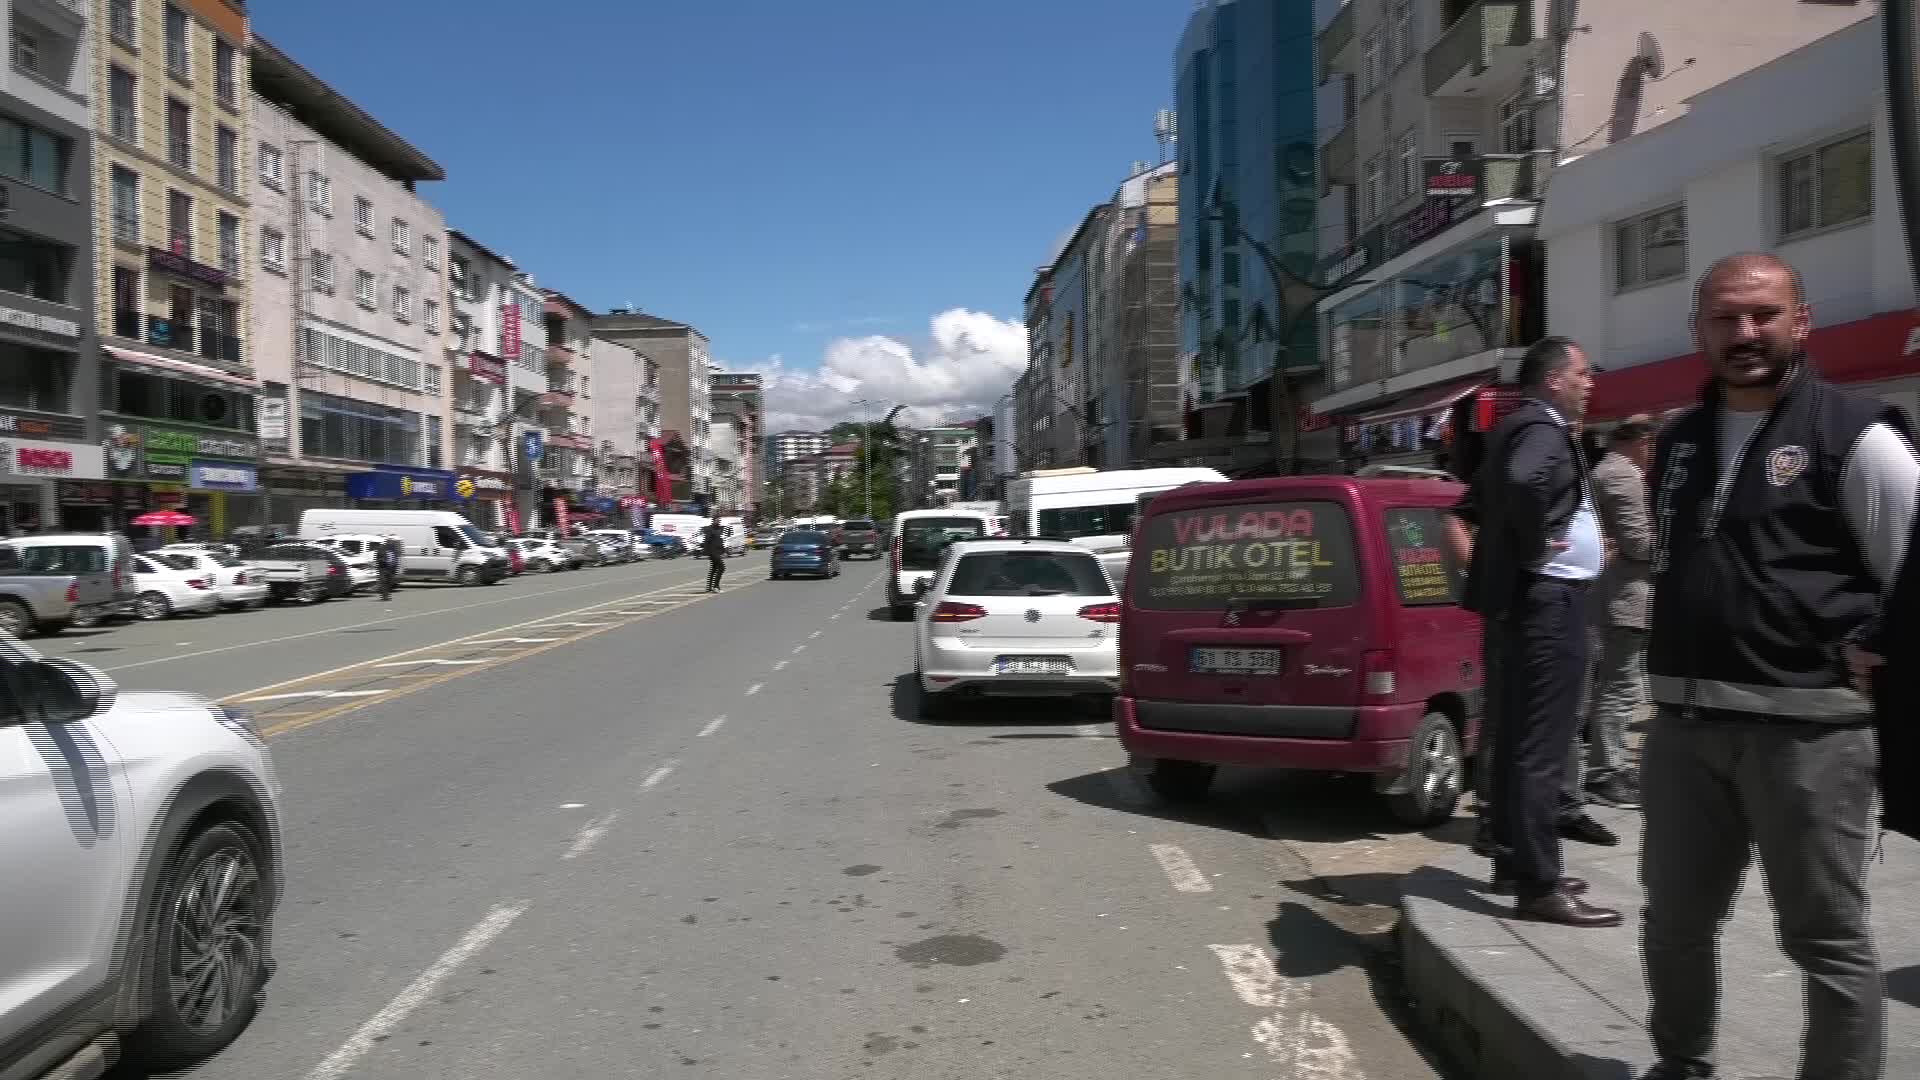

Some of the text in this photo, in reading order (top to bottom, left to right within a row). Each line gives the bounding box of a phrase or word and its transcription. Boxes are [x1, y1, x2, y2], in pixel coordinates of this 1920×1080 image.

[1172, 508, 1315, 544] VULADA
[1151, 538, 1333, 573] BUTİK OTEL
[1198, 650, 1279, 668] 61 TS 558
